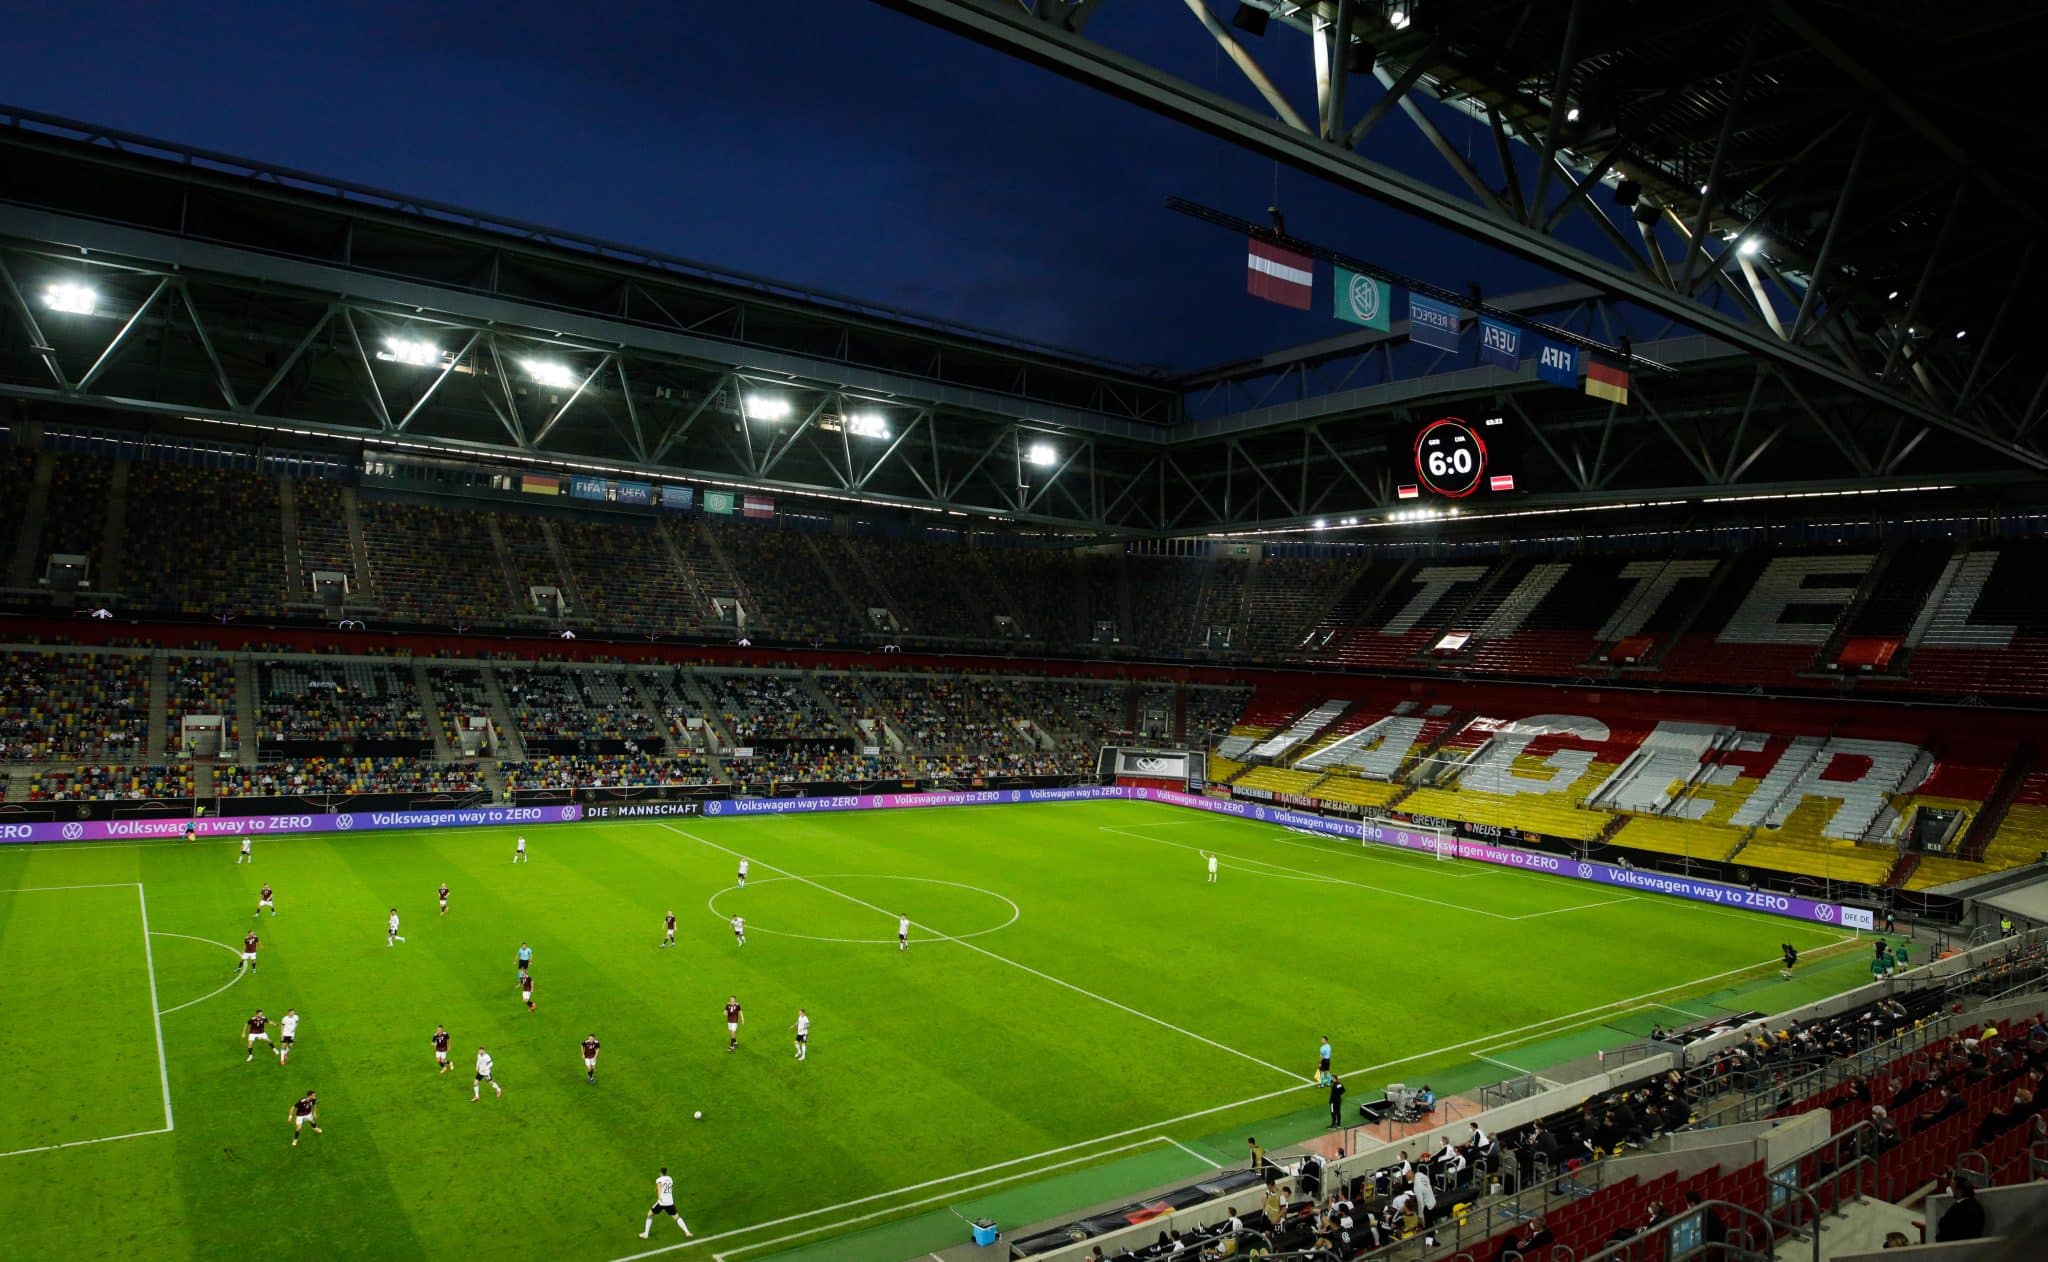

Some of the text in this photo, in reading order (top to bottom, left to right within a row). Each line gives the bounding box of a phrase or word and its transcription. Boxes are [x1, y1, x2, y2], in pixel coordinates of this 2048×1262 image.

[1428, 448, 1472, 476] 6:0
[576, 482, 600, 493] FIFA
[622, 487, 646, 498] UEFA
[894, 790, 1000, 806] Volkswagen way to ZERO
[1030, 786, 1122, 800] Volkswagen way to ZERO
[1156, 790, 1244, 813] Volkswagen way to ZERO
[588, 803, 698, 817] DIE MANNSCHAFT
[735, 796, 858, 813] Volkswagen way to ZERO
[372, 808, 542, 826] Volkswagen way to ZERO
[1273, 810, 1382, 839] Volkswagen way to ZERO
[1411, 814, 1448, 828] GREVEN
[106, 816, 312, 836] Volkswagn way to ZERO
[1472, 823, 1502, 837] NEUSS
[1420, 835, 1559, 870] Volkswagen way to ZERO
[1608, 868, 1789, 910] Volkswagen way to ZERO
